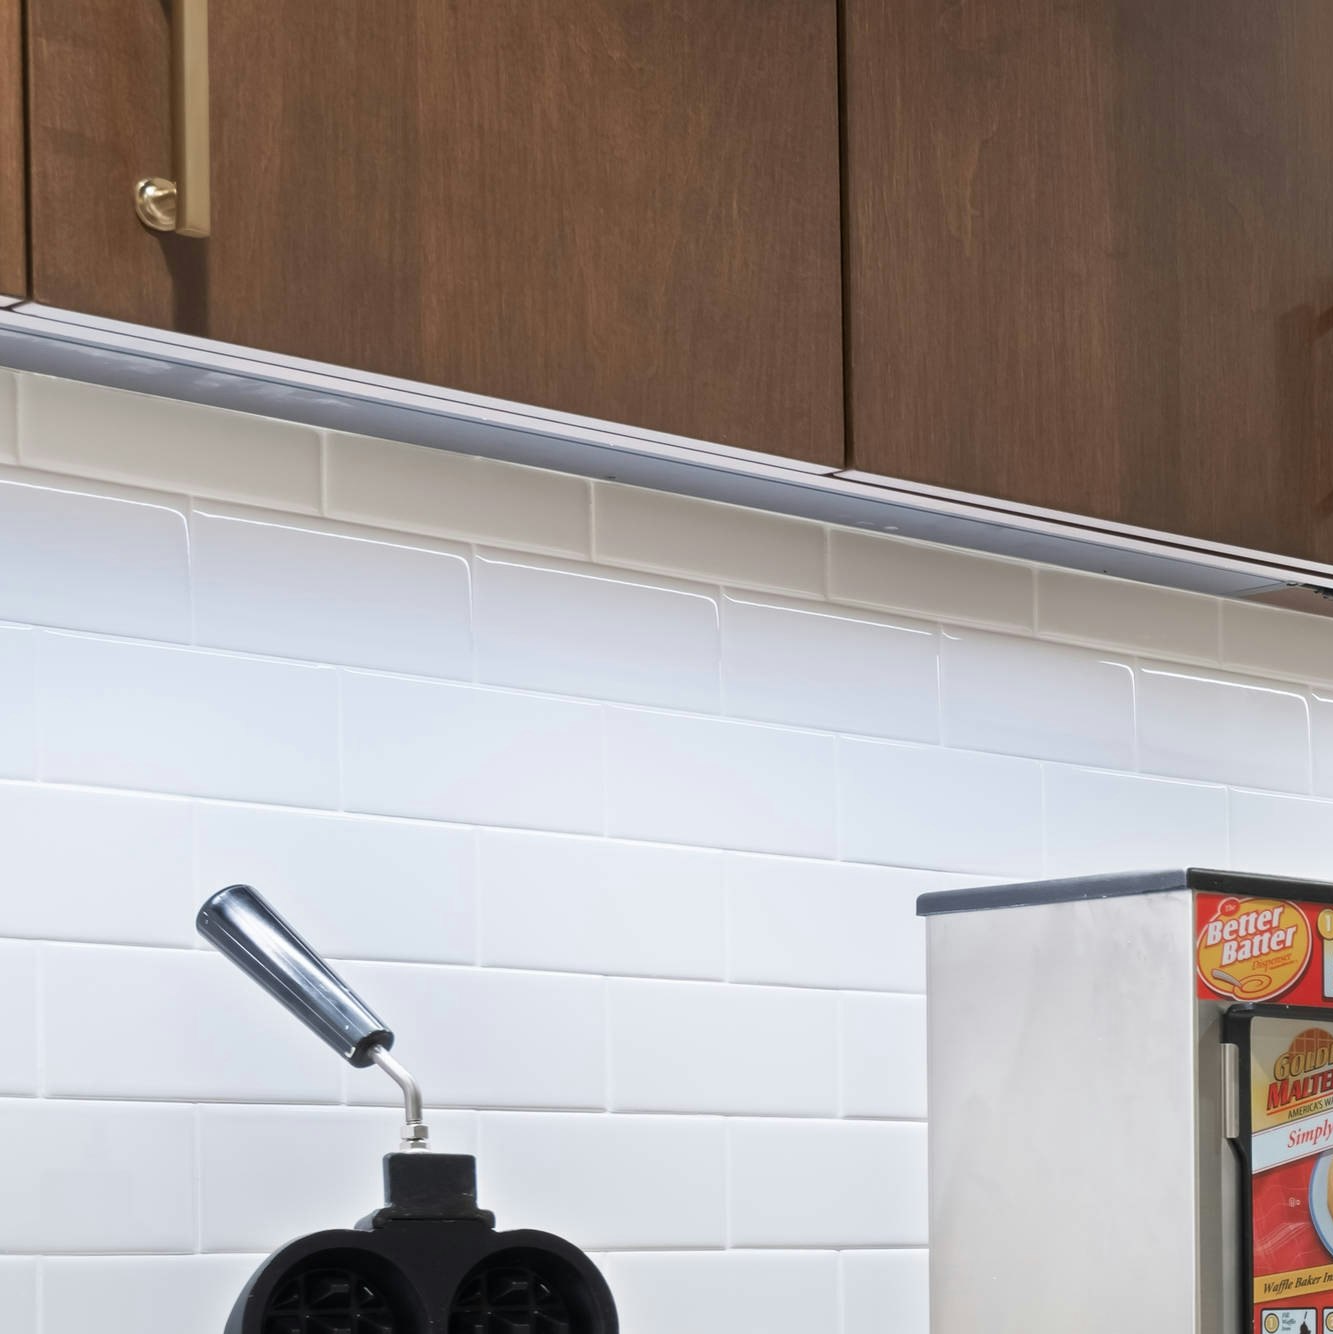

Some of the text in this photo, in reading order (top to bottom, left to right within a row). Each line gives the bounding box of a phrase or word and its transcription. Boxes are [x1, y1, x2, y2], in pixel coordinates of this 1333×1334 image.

[1206, 905, 1285, 947] Better
[1324, 914, 1332, 932] 1
[1221, 925, 1298, 967] Batter
[1288, 1101, 1323, 1119] AMERICA'S
[1287, 1119, 1333, 1149] Simply
[1263, 1279, 1293, 1296] Waffle
[1295, 1274, 1321, 1288] Baker
